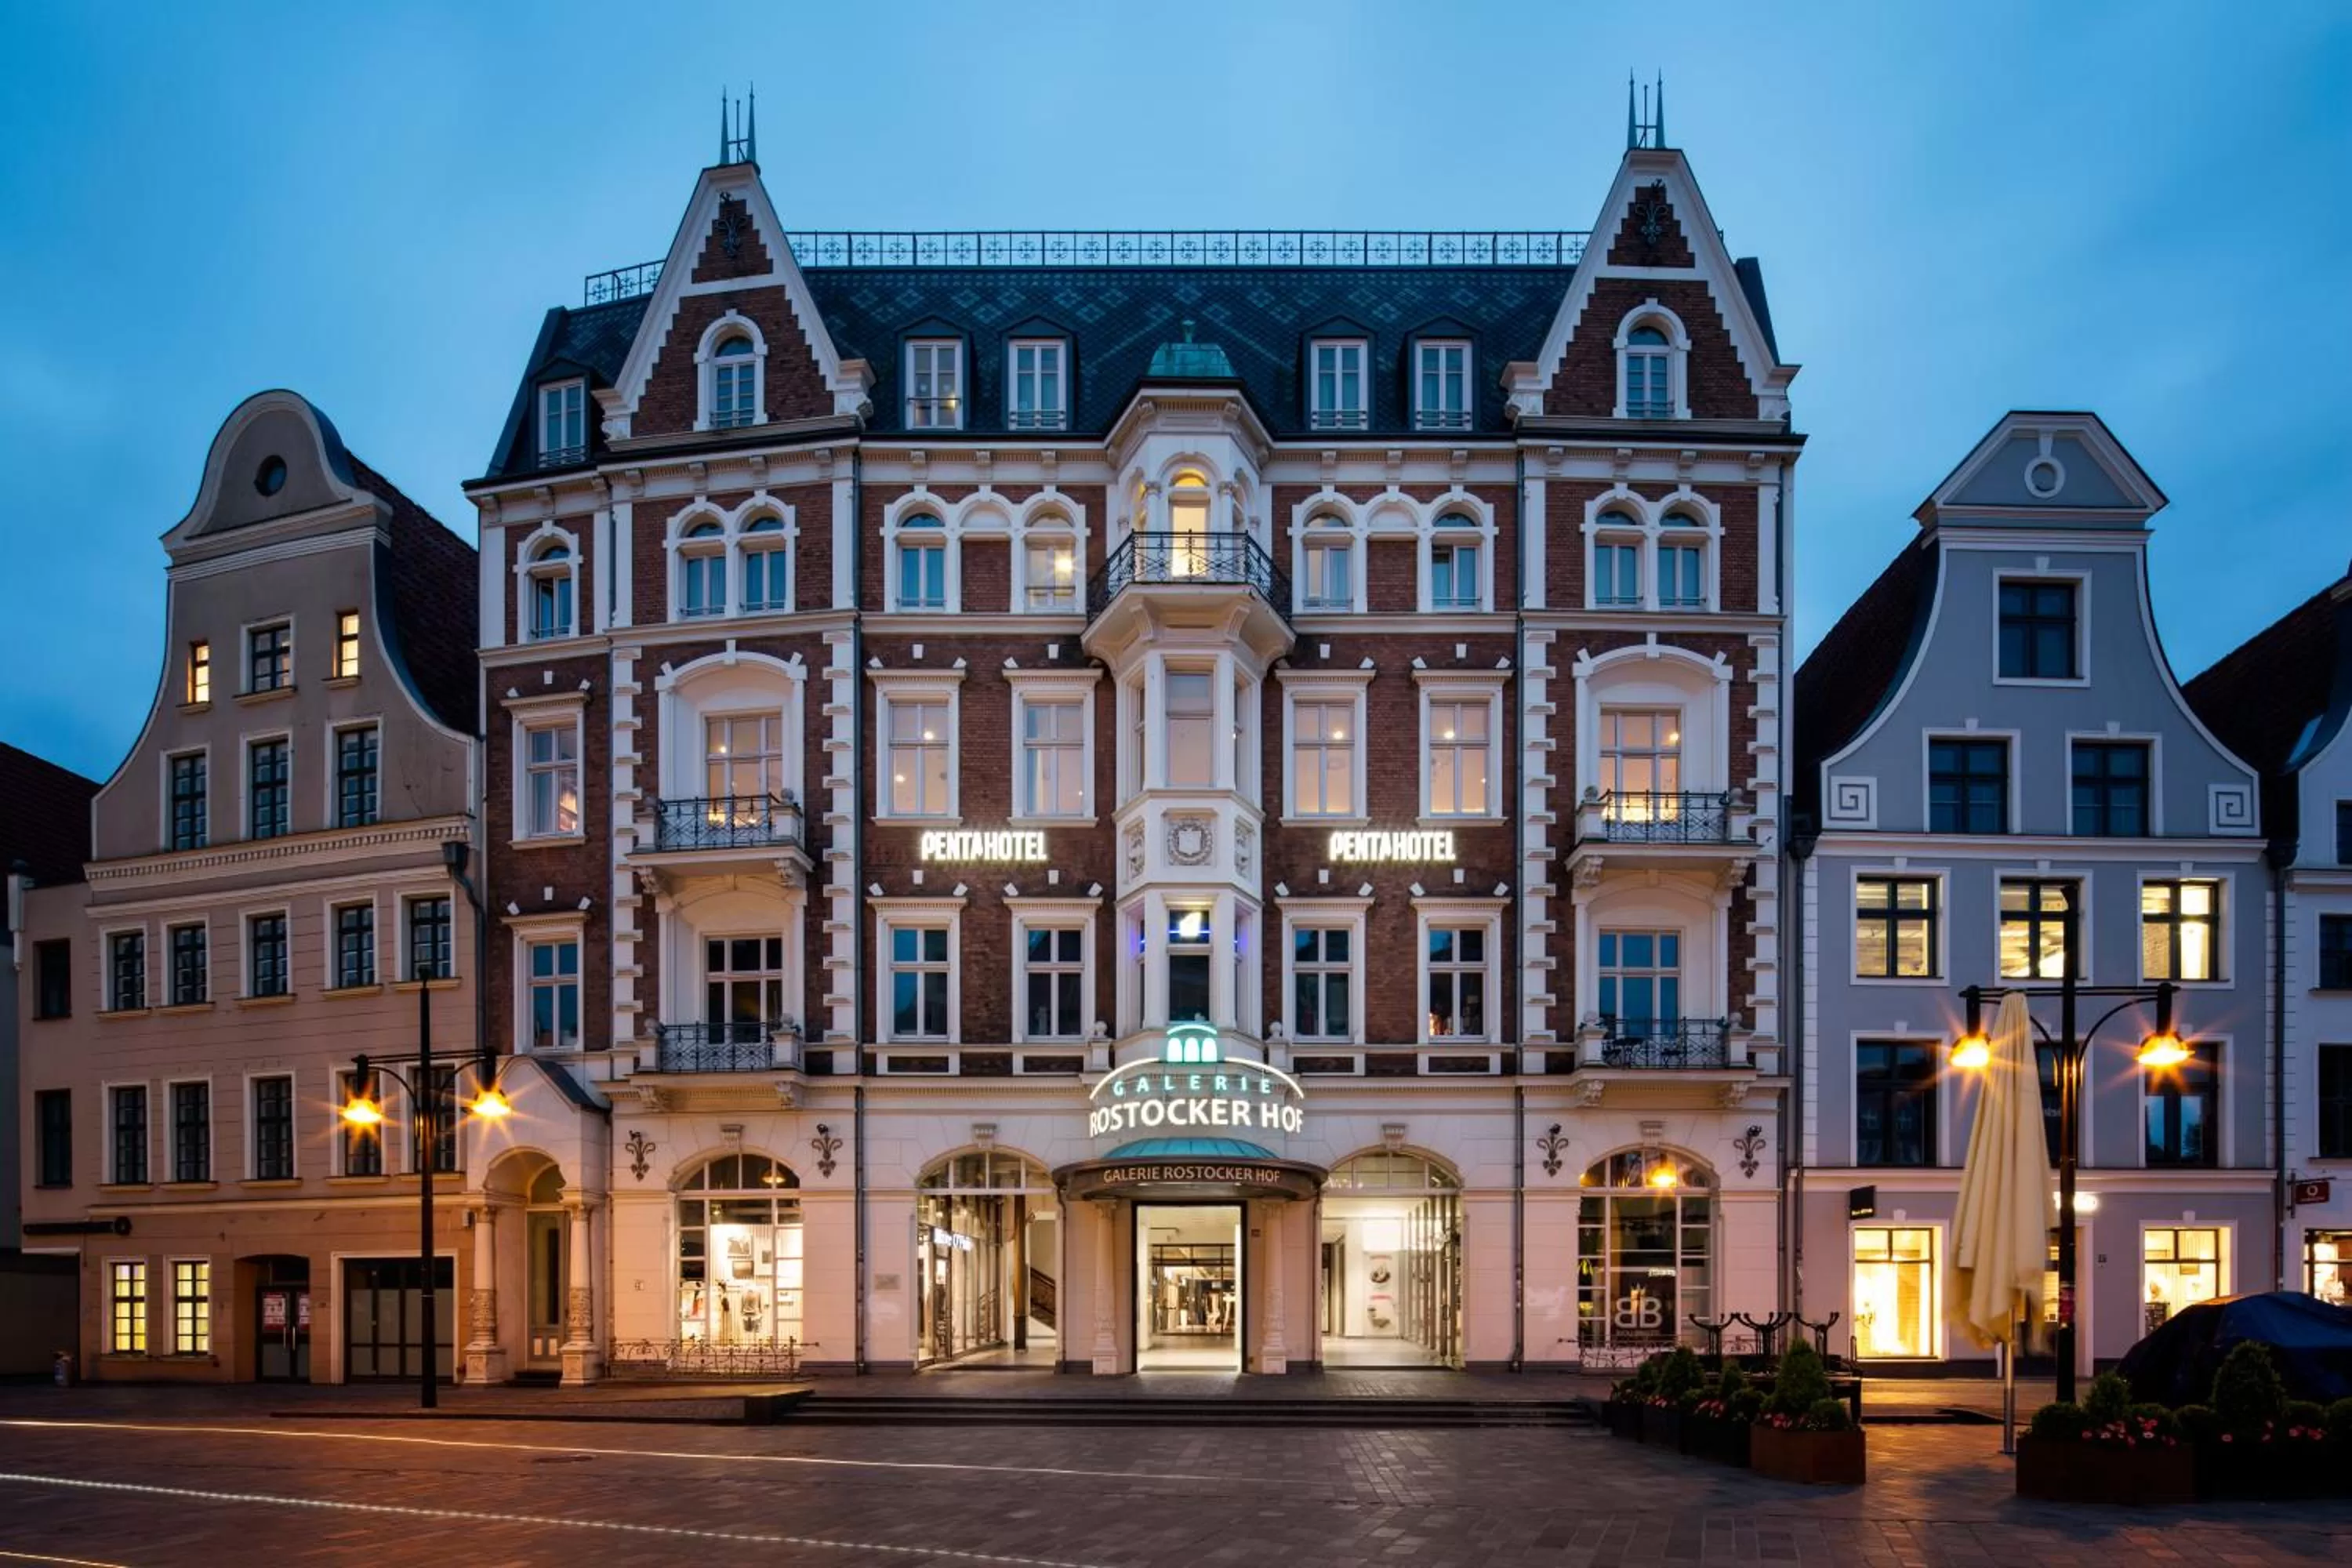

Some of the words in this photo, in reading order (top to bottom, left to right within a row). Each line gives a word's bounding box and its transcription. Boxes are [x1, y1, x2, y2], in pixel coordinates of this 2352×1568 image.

[921, 830, 1047, 861] PENTAHOTEL
[1330, 830, 1457, 861] PENTAHOTEL
[1113, 1074, 1272, 1096] GALERIE
[1089, 1098, 1251, 1138] ROSTOCKER
[1261, 1102, 1305, 1134] HOF
[1103, 1166, 1160, 1183] GALERIE
[1163, 1165, 1253, 1181] ROSTOCKER
[1256, 1169, 1280, 1182] HOF
